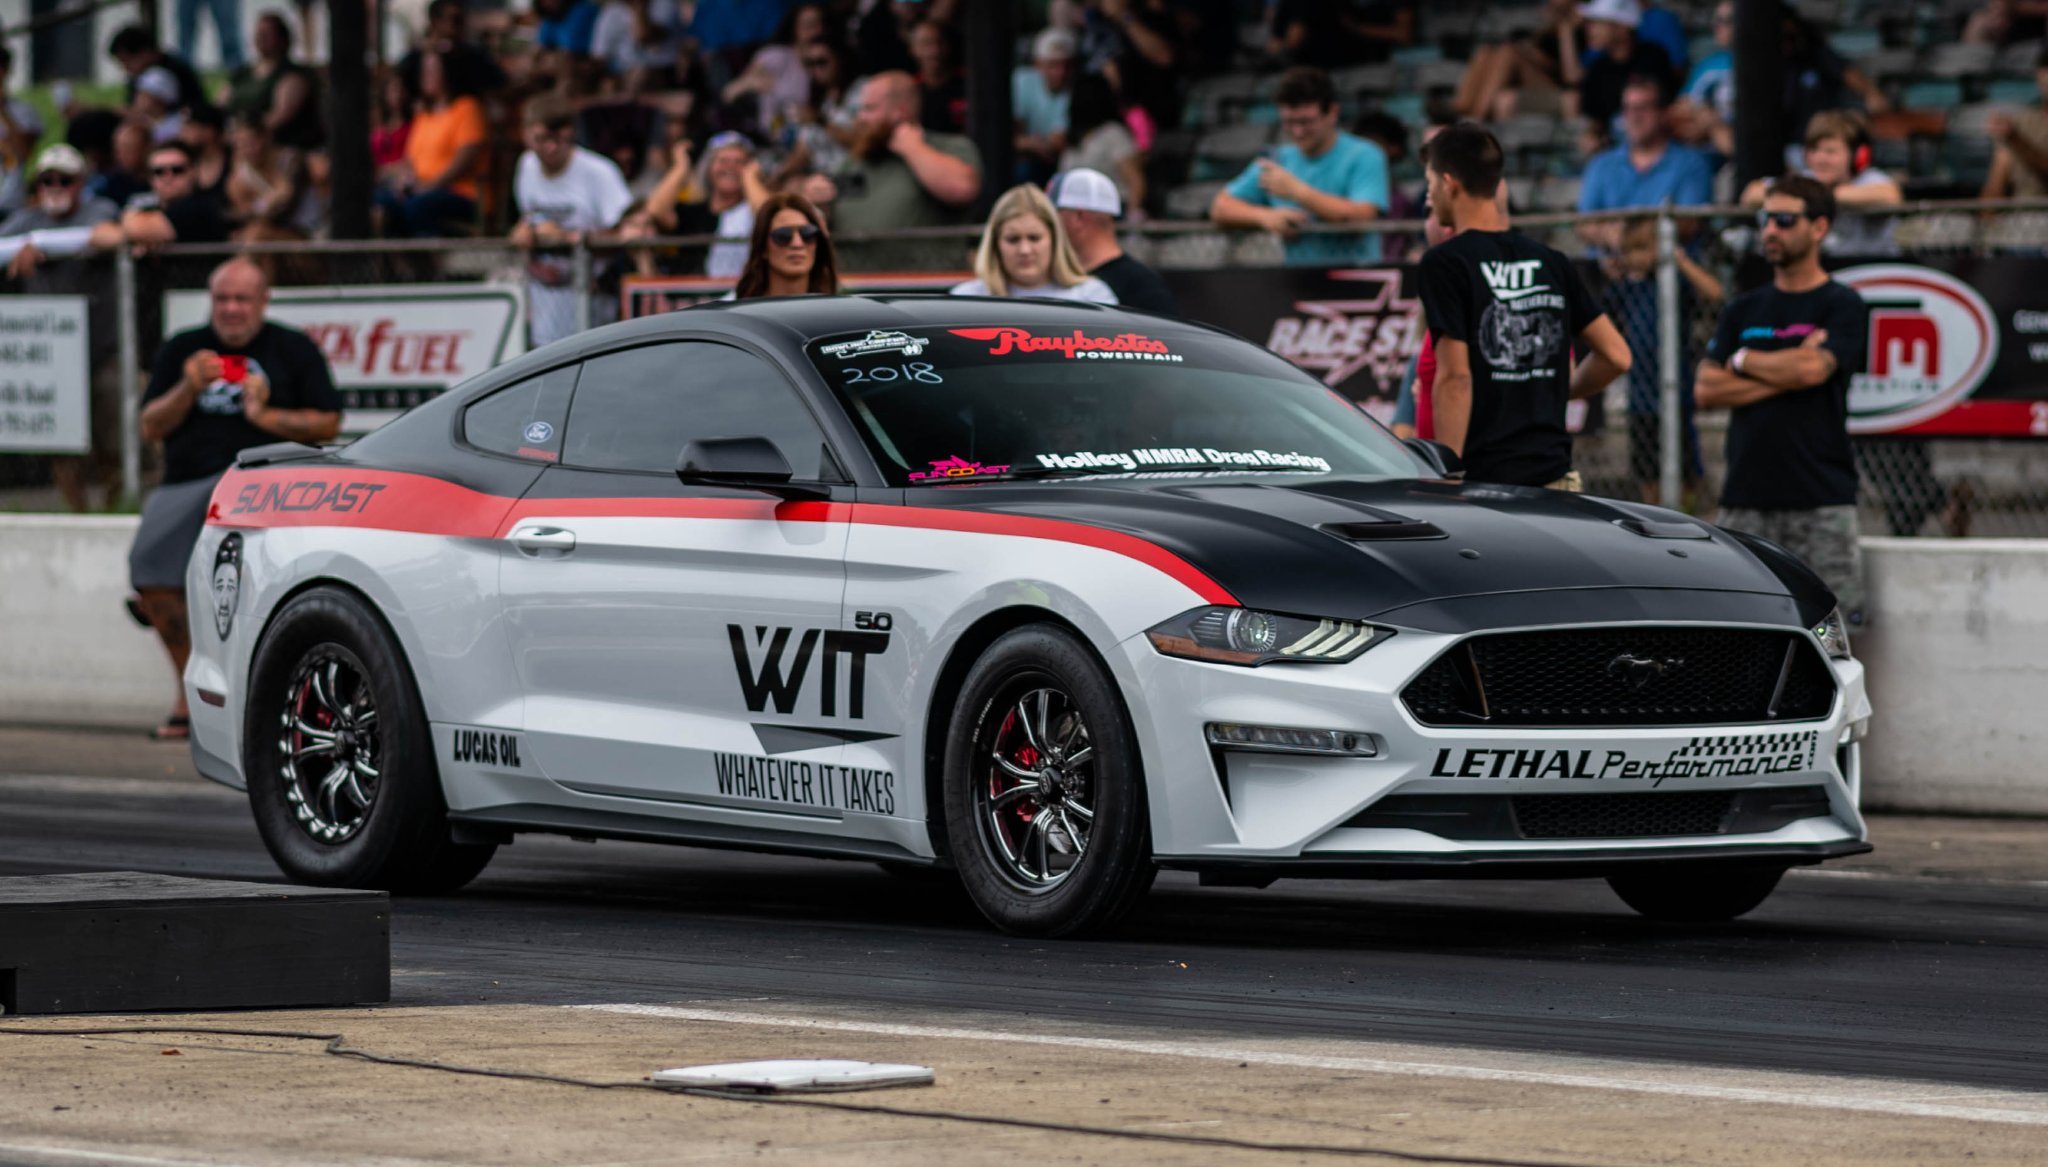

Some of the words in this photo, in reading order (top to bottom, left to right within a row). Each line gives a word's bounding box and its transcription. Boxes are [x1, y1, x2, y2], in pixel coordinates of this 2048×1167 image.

[1480, 259, 1542, 289] WIT
[1267, 317, 1378, 356] RACE
[842, 362, 943, 384] 2018
[1076, 351, 1183, 362] POWERTRAIN
[908, 465, 1011, 481] SUNCOAST
[1036, 452, 1137, 470] Holley
[1132, 448, 1206, 465] NMRA
[230, 481, 388, 515] SUNCOAST
[726, 623, 891, 719] WIT
[453, 729, 498, 766] LUCAS
[500, 733, 522, 768] OIL
[714, 752, 815, 805] WHATEVER
[819, 763, 835, 807] IT
[839, 767, 895, 815] TAKES
[1430, 748, 1599, 779] LETHAL
[1598, 751, 1804, 788] Performance
